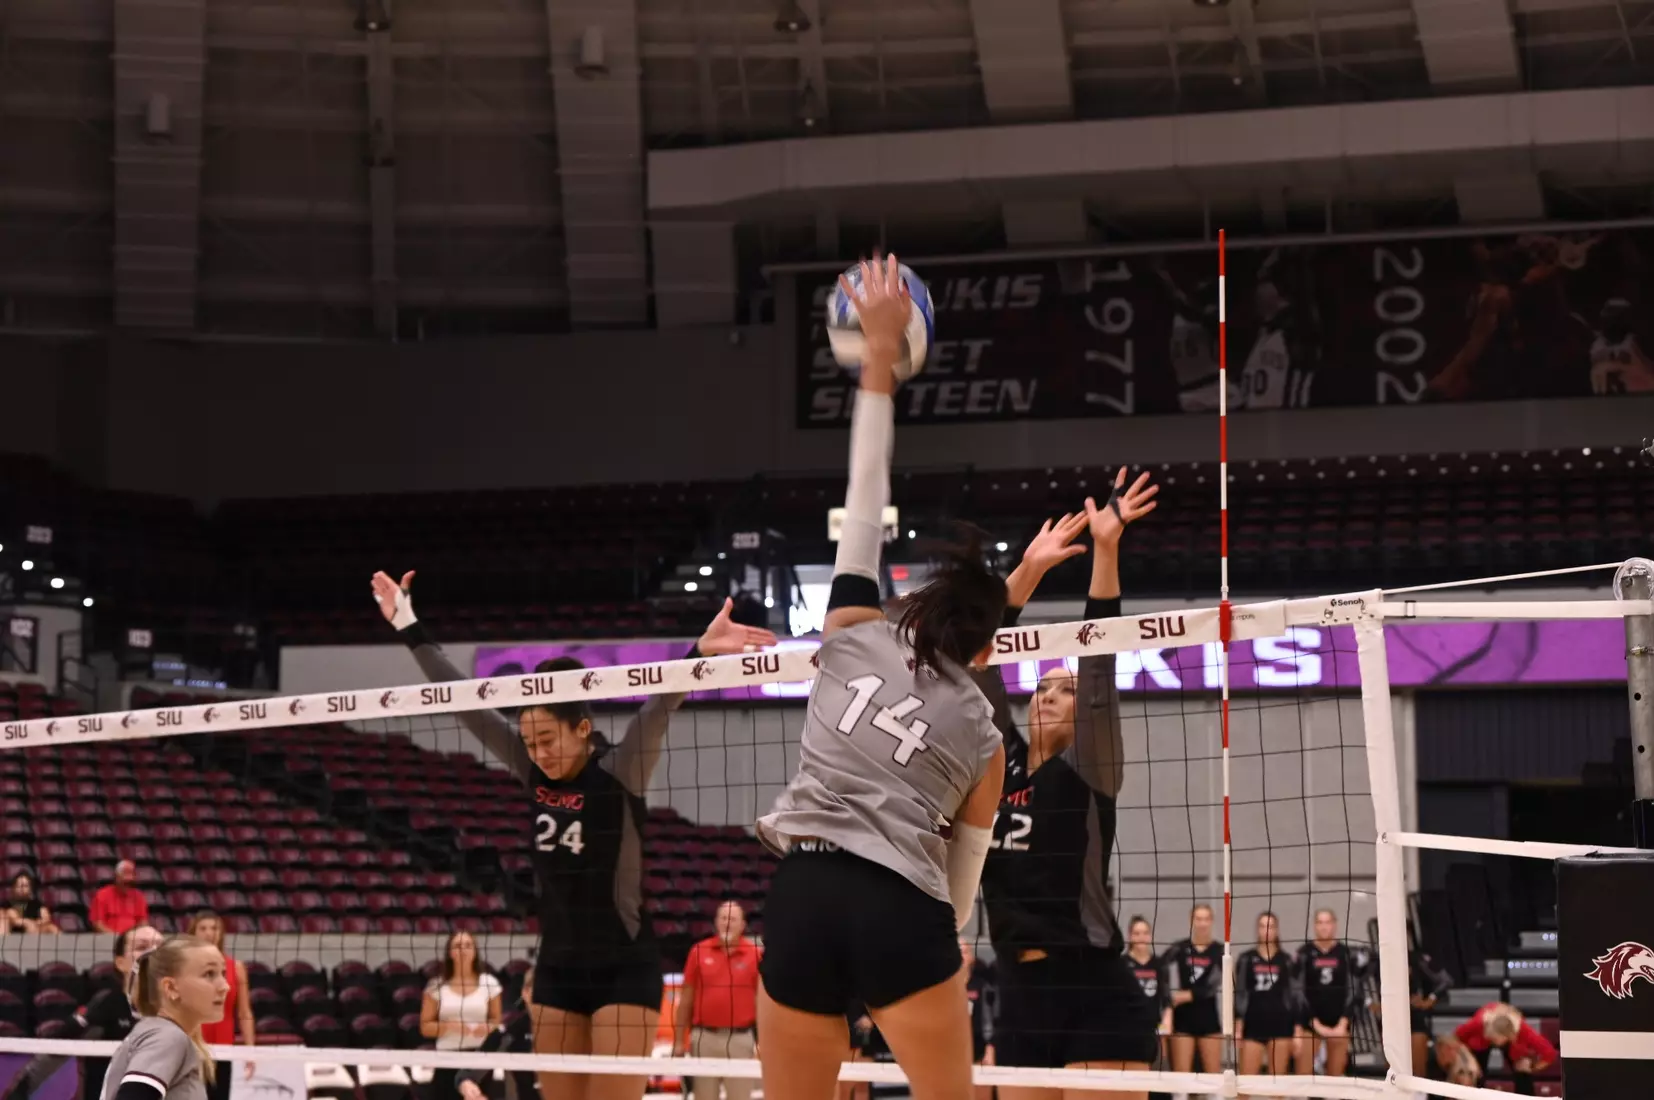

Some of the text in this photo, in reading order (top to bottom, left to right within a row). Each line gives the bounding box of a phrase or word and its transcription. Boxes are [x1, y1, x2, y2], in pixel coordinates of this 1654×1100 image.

[1083, 261, 1135, 415] 1977
[1373, 247, 1427, 404] 2002
[5, 615, 1186, 740] SIU SIU SIU SIU SIU SIU SIU SIU SIU SIU SIU
[836, 673, 931, 768] 14
[534, 813, 586, 855] 24
